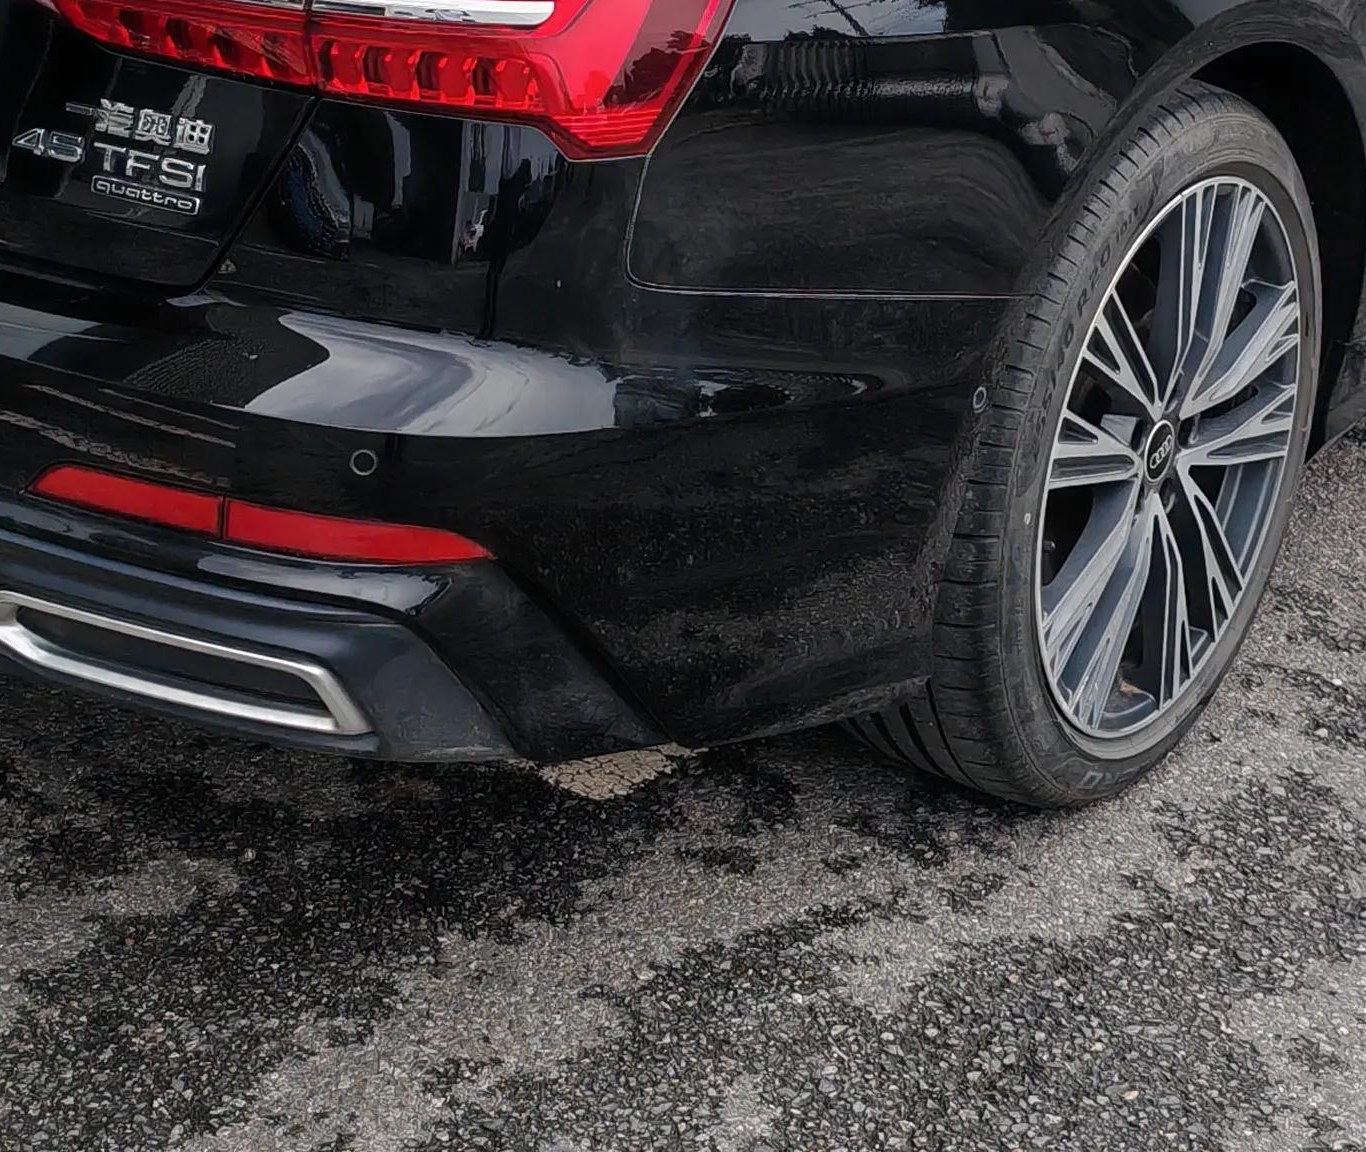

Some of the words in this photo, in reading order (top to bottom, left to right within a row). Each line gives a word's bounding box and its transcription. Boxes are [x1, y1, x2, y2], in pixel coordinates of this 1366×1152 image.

[65, 99, 213, 154] 一汽奥迪
[12, 127, 85, 163] 45
[93, 141, 206, 192] TFSI
[95, 179, 195, 211] quattro
